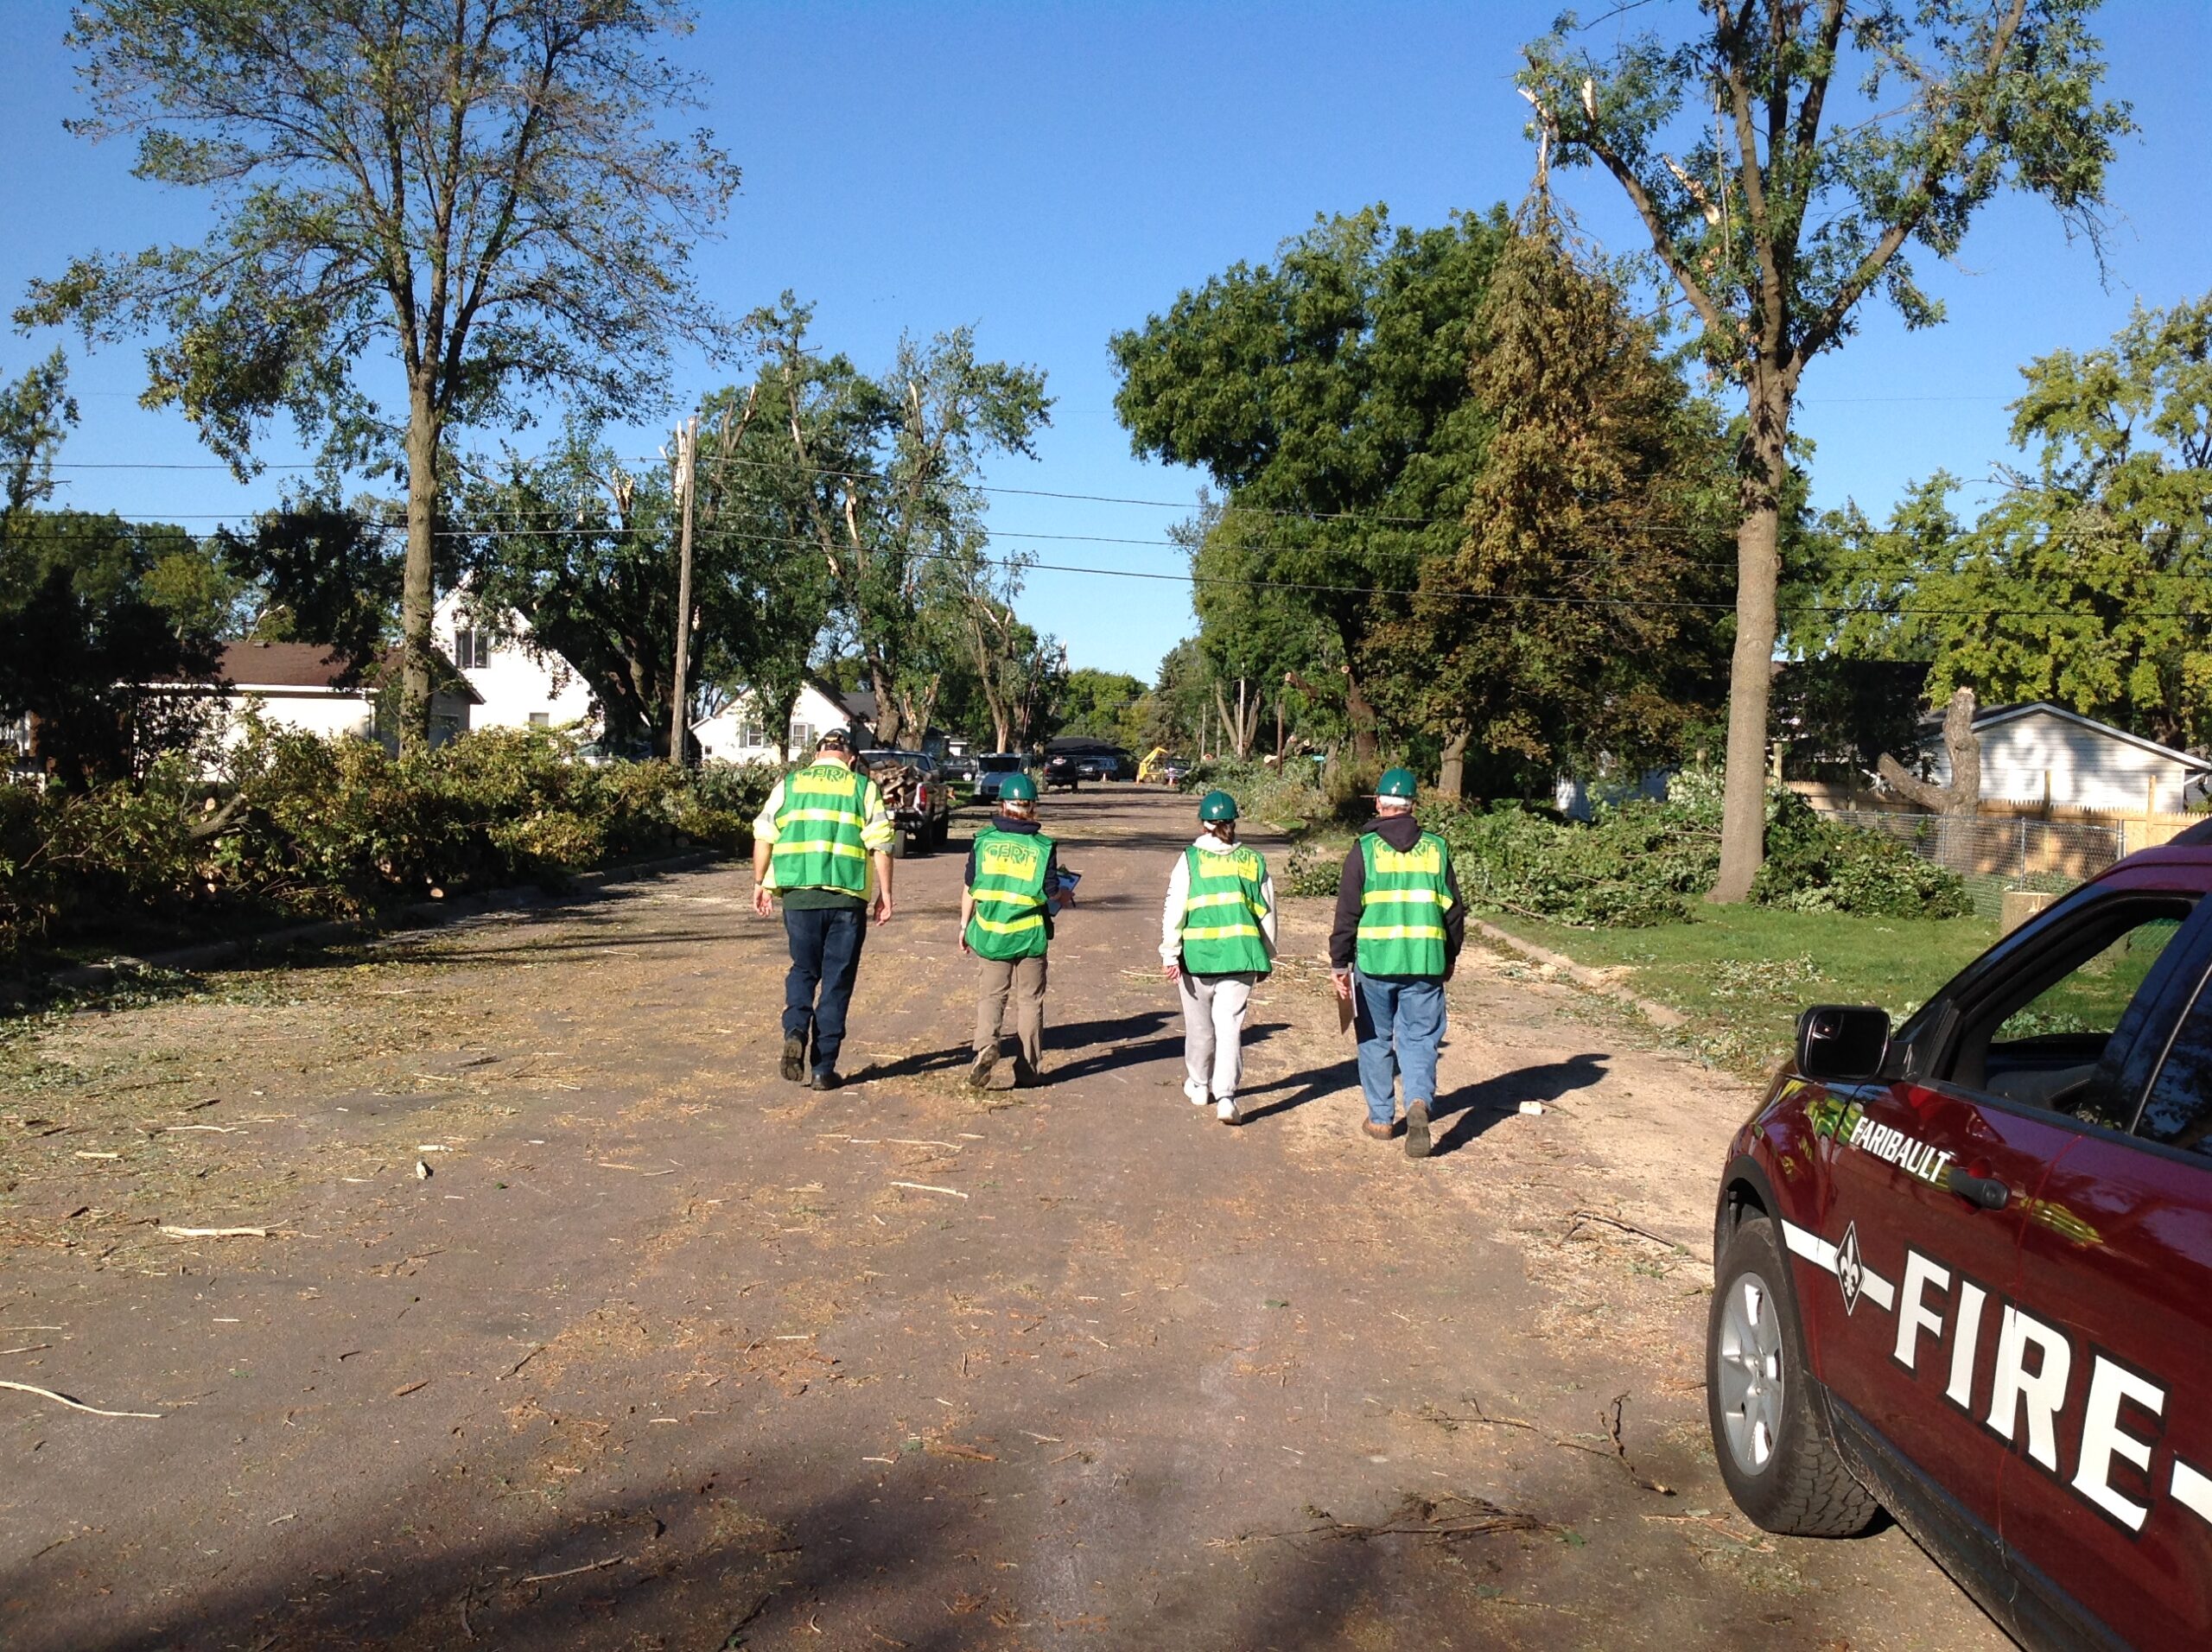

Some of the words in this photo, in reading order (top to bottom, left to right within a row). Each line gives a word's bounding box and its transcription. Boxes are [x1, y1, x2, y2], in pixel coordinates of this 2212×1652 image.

[985, 843, 1038, 865] CERT
[1849, 1116, 1952, 1183] FARIBAULT
[1894, 1249, 2165, 1533] FIRE
